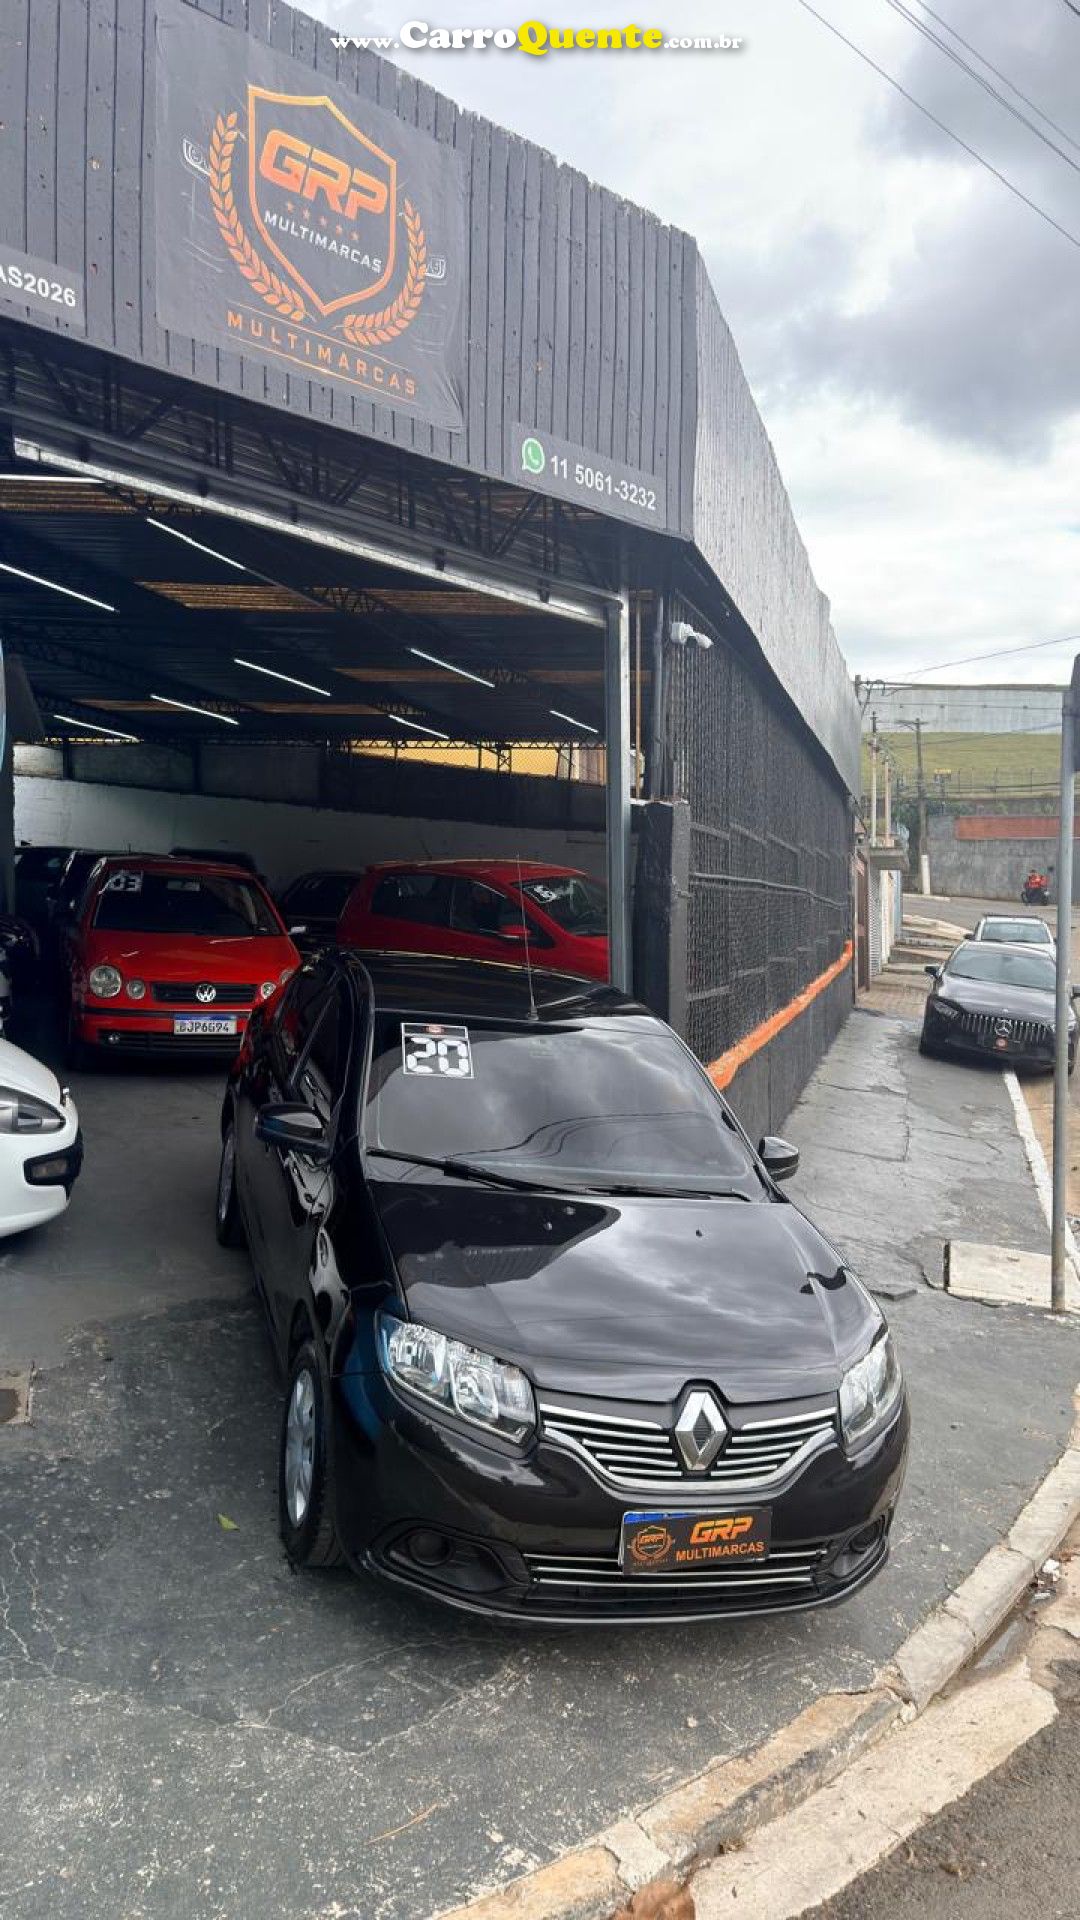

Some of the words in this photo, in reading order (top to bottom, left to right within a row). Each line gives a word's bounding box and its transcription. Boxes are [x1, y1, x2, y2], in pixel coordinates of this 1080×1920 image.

[260, 129, 388, 220] GRP
[264, 210, 383, 274] MULTIMARCAS
[227, 310, 416, 396] MULTIMARCAS
[551, 455, 568, 479] 11
[575, 463, 657, 511] 5061-3232
[406, 1037, 470, 1077] 20
[676, 1541, 765, 1562] MULTIMARCAS
[690, 1516, 753, 1544] GRP
